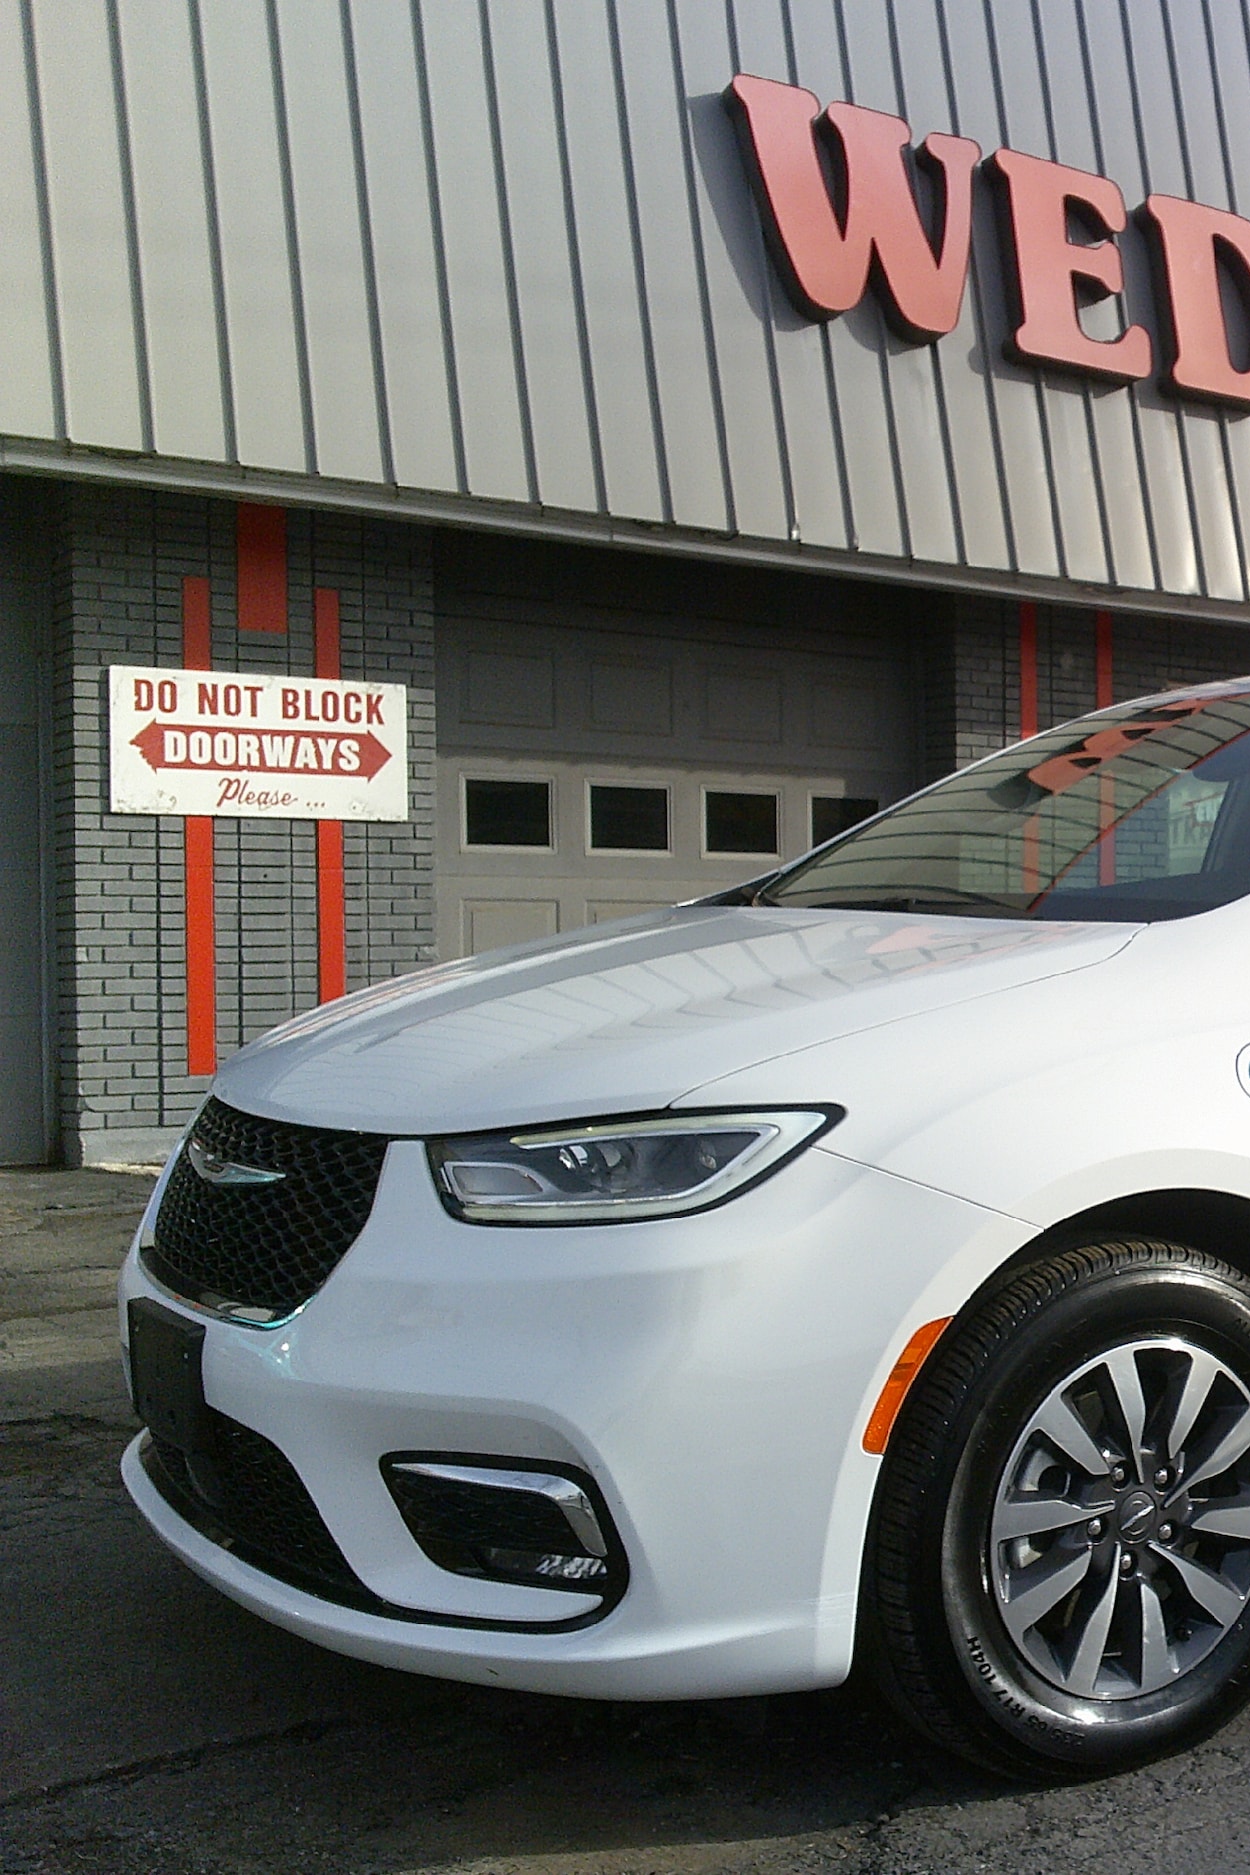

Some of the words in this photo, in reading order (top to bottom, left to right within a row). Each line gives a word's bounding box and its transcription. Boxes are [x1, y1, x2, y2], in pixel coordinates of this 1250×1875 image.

[134, 679, 177, 713] DO
[198, 683, 263, 717] NOT
[282, 688, 385, 725] BLOCK
[164, 730, 360, 771] DOORWAYS
